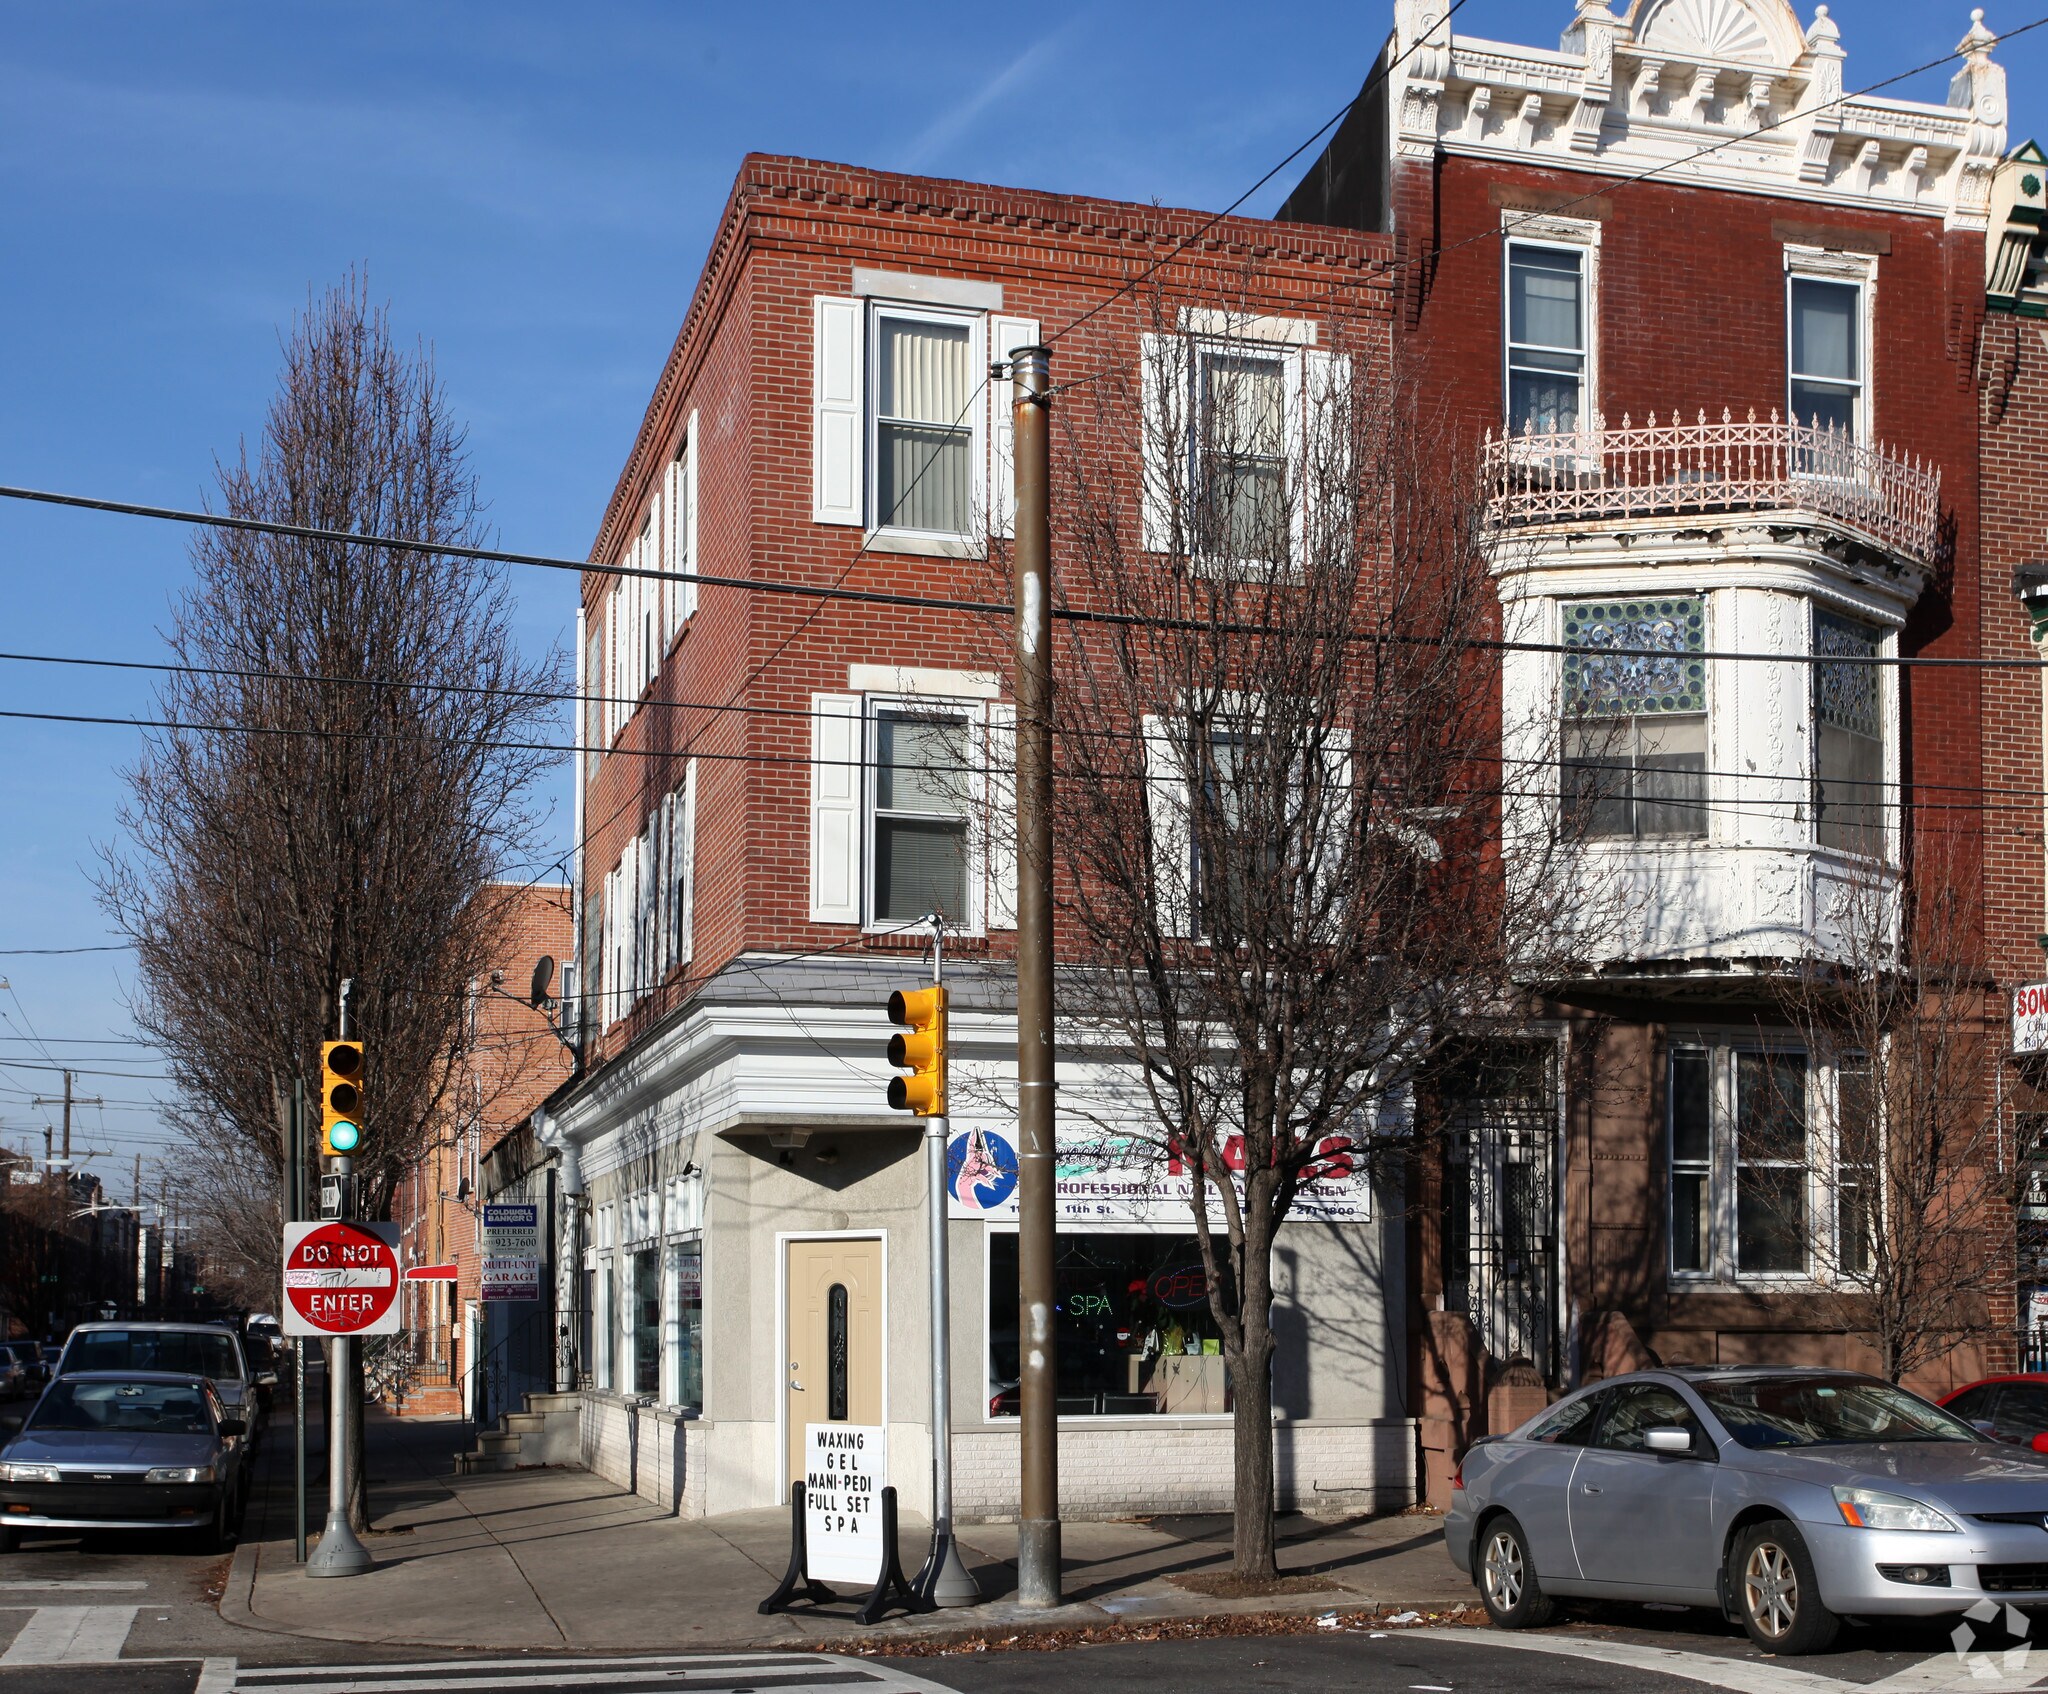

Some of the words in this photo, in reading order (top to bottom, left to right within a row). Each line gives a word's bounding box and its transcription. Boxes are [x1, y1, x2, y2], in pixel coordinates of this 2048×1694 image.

[1168, 1133, 1353, 1179] NAS
[1057, 1183, 1172, 1195] ROFESSIONAL
[1178, 1184, 1216, 1195] NIL
[487, 1208, 533, 1216] COLDWELL
[1065, 1205, 1090, 1214] 11th
[1096, 1205, 1115, 1214] St.
[1290, 1206, 1355, 1215] -271-1800
[495, 1238, 537, 1247] 923-7600
[303, 1245, 329, 1262] DO
[343, 1245, 382, 1262] NOT
[483, 1260, 537, 1270] MULTI-UNIT
[483, 1272, 537, 1281] GARAGE
[1154, 1275, 1212, 1300] OPE
[310, 1294, 374, 1311] ENTER
[1069, 1294, 1113, 1315] SPA
[817, 1431, 864, 1450] WAXING
[808, 1493, 837, 1512] FULL
[847, 1496, 870, 1513] SET
